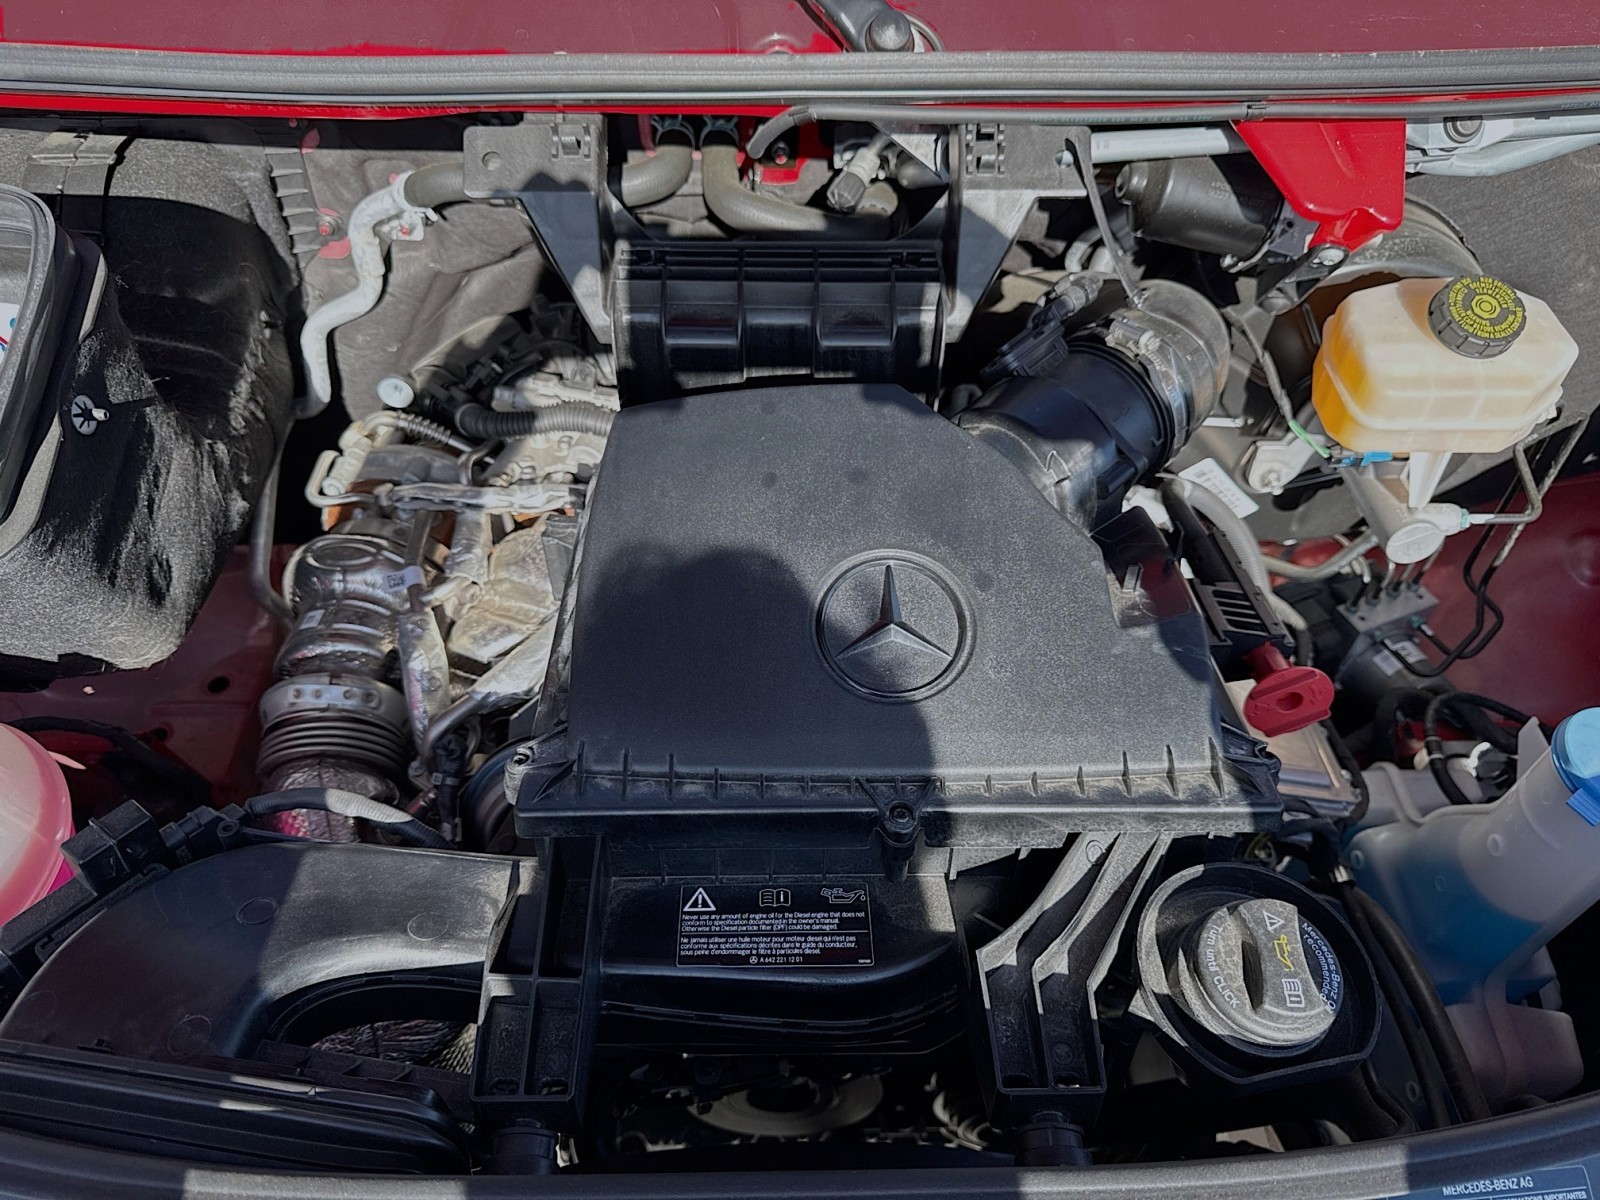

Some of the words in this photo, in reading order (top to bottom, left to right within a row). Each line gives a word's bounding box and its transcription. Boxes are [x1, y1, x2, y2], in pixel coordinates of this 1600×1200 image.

[1206, 924, 1223, 947] Turn
[1302, 922, 1340, 1000] Mercedes-Benz
[1304, 934, 1330, 1000] recommended
[1214, 976, 1240, 1009] CLICK
[1442, 1178, 1518, 1196] MERCEDES-BENZ
[1520, 1176, 1534, 1188] AG
